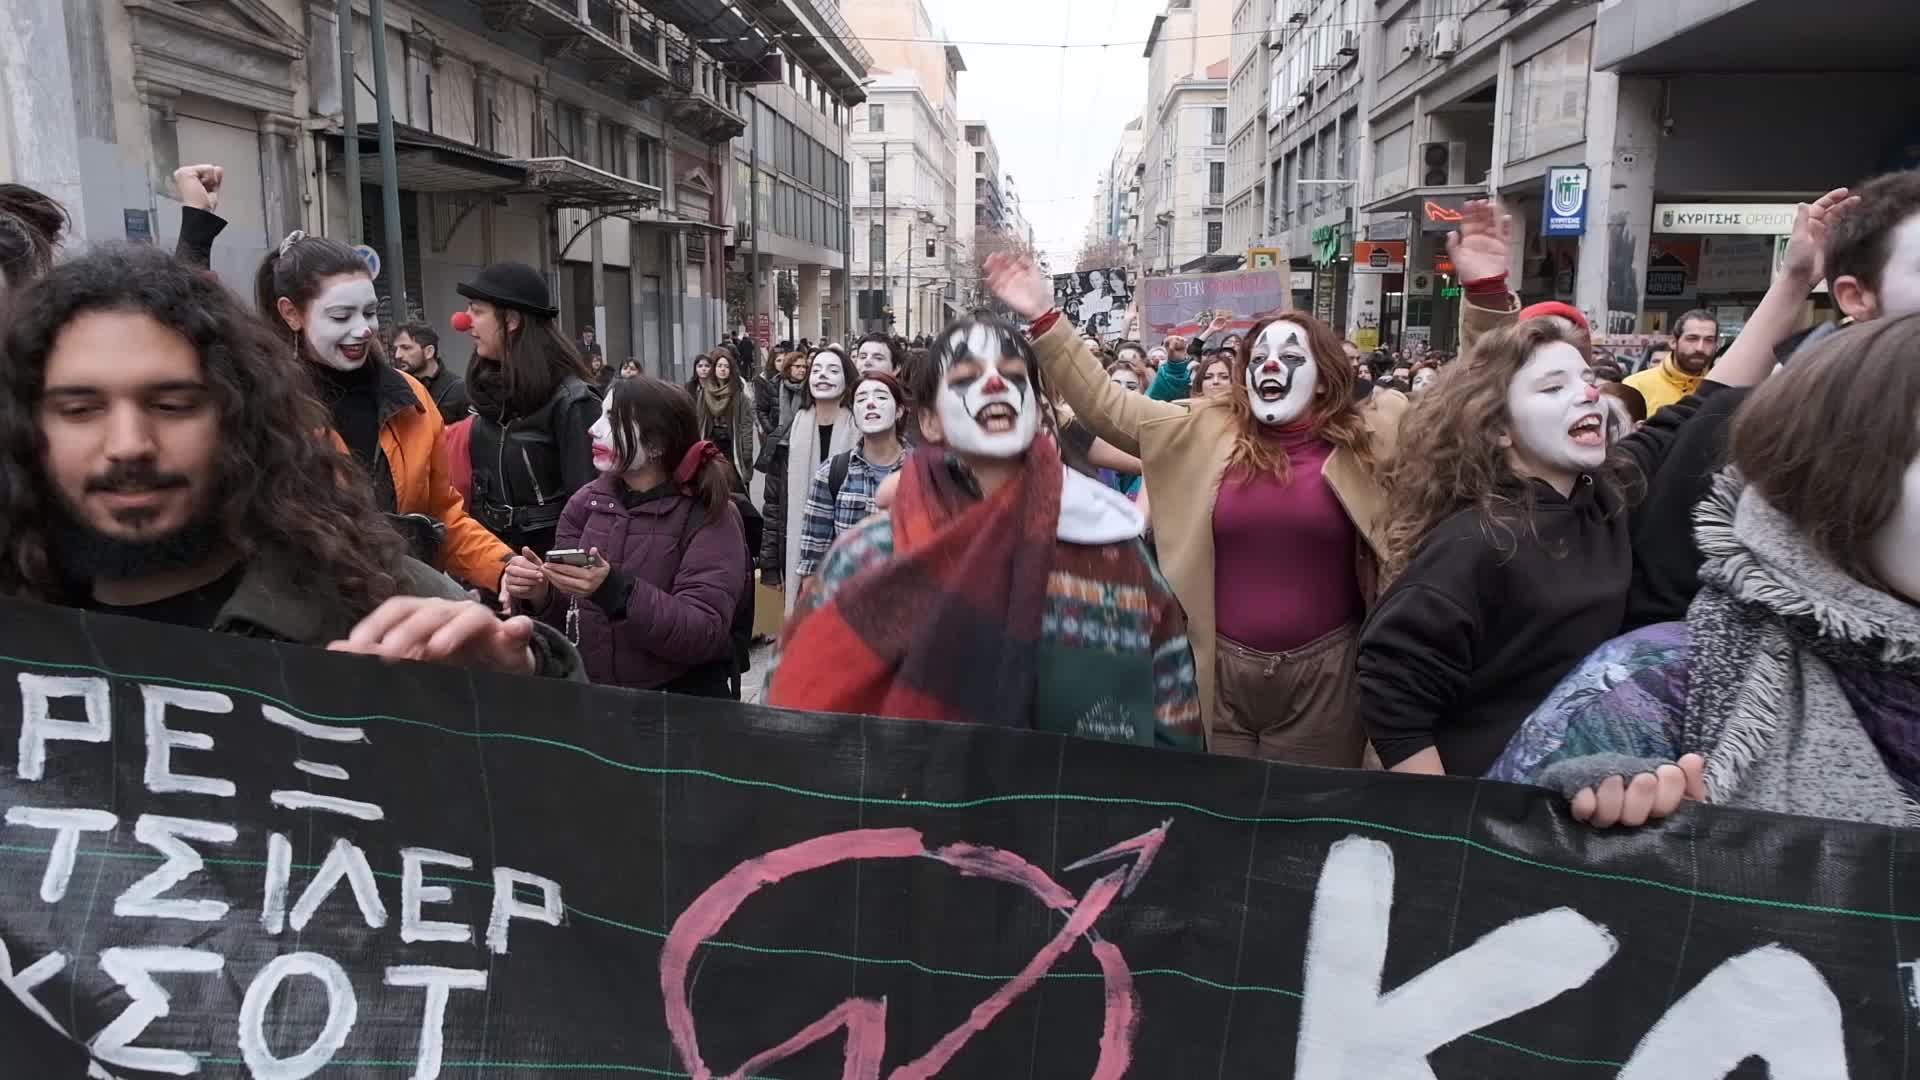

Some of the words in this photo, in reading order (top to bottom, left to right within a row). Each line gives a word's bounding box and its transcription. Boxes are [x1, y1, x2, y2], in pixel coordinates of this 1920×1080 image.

[1677, 213, 1742, 225] ΚΥΡΙΤΣΗΣ
[17, 672, 385, 821] ΡΕΞ
[5, 806, 563, 954] ΤΣΙΛΕΡ
